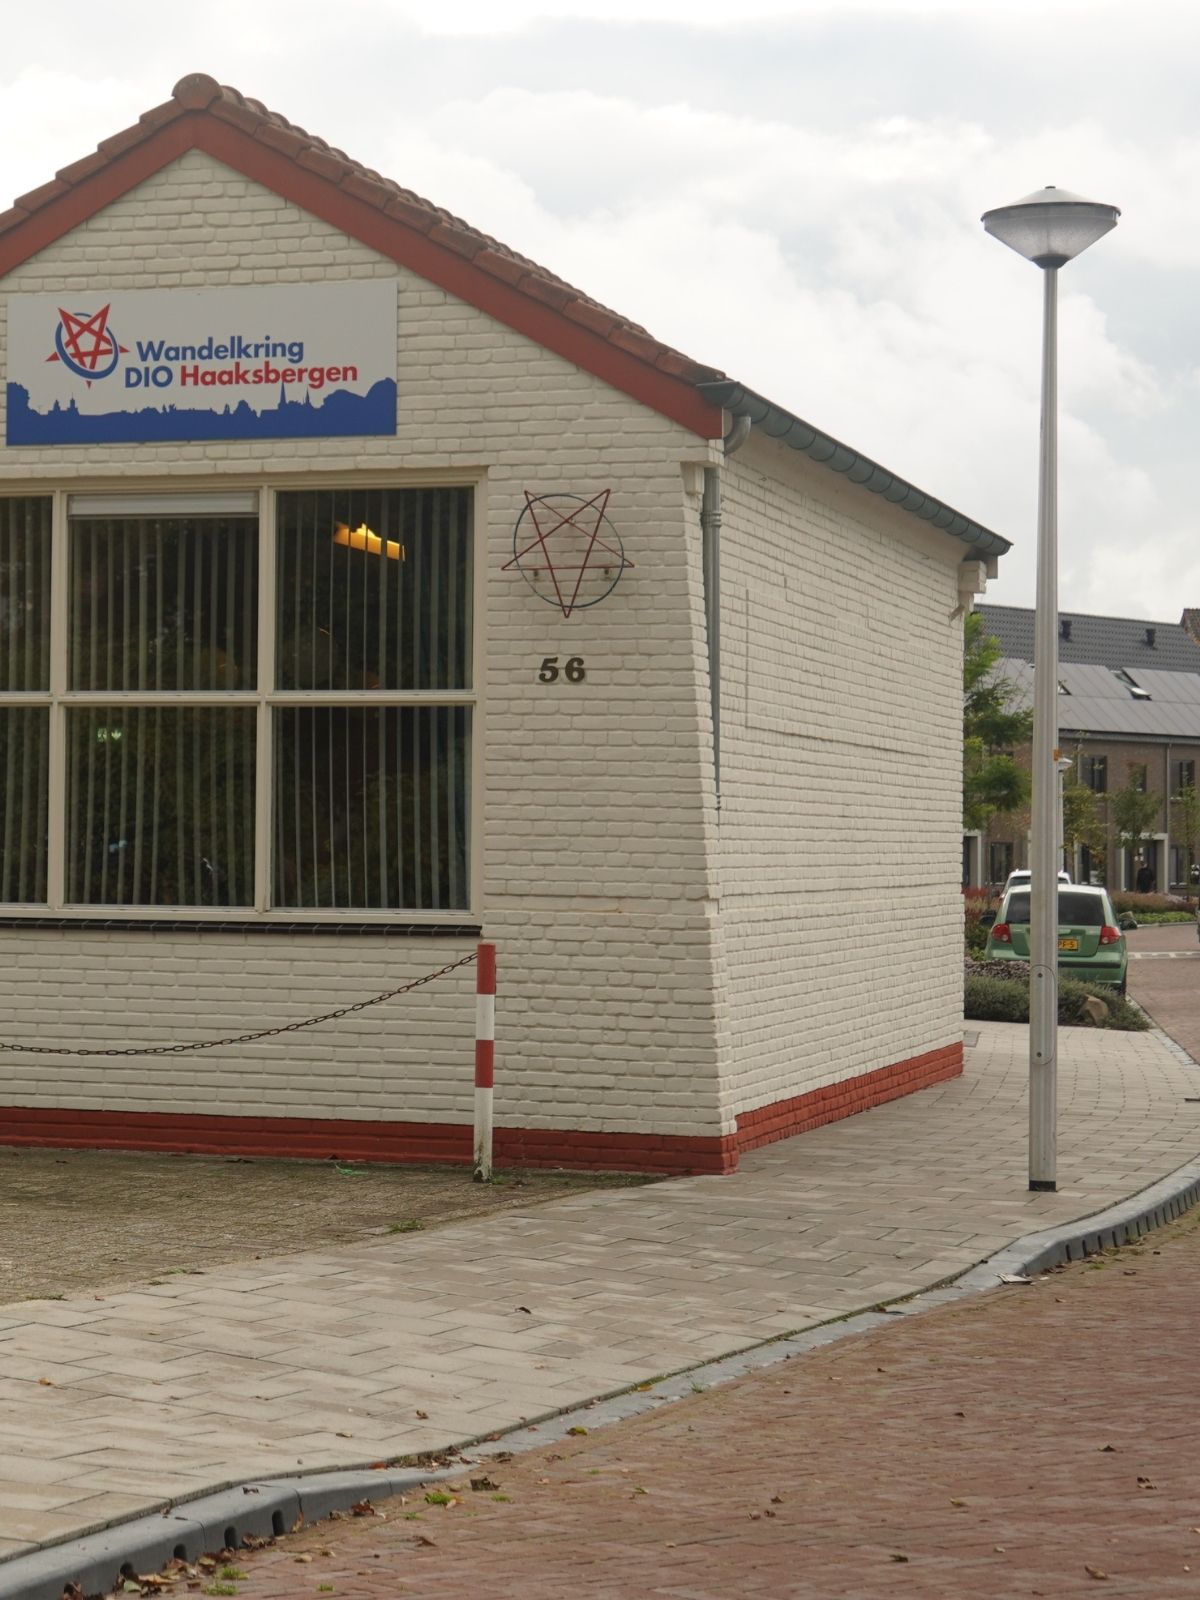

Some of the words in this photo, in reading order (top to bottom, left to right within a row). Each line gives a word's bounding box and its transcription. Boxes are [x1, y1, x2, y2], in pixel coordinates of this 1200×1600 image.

[136, 335, 304, 364] Wandelkring
[125, 366, 173, 388] DIO
[181, 361, 358, 389] Haaksbergen
[538, 657, 586, 683] 56
